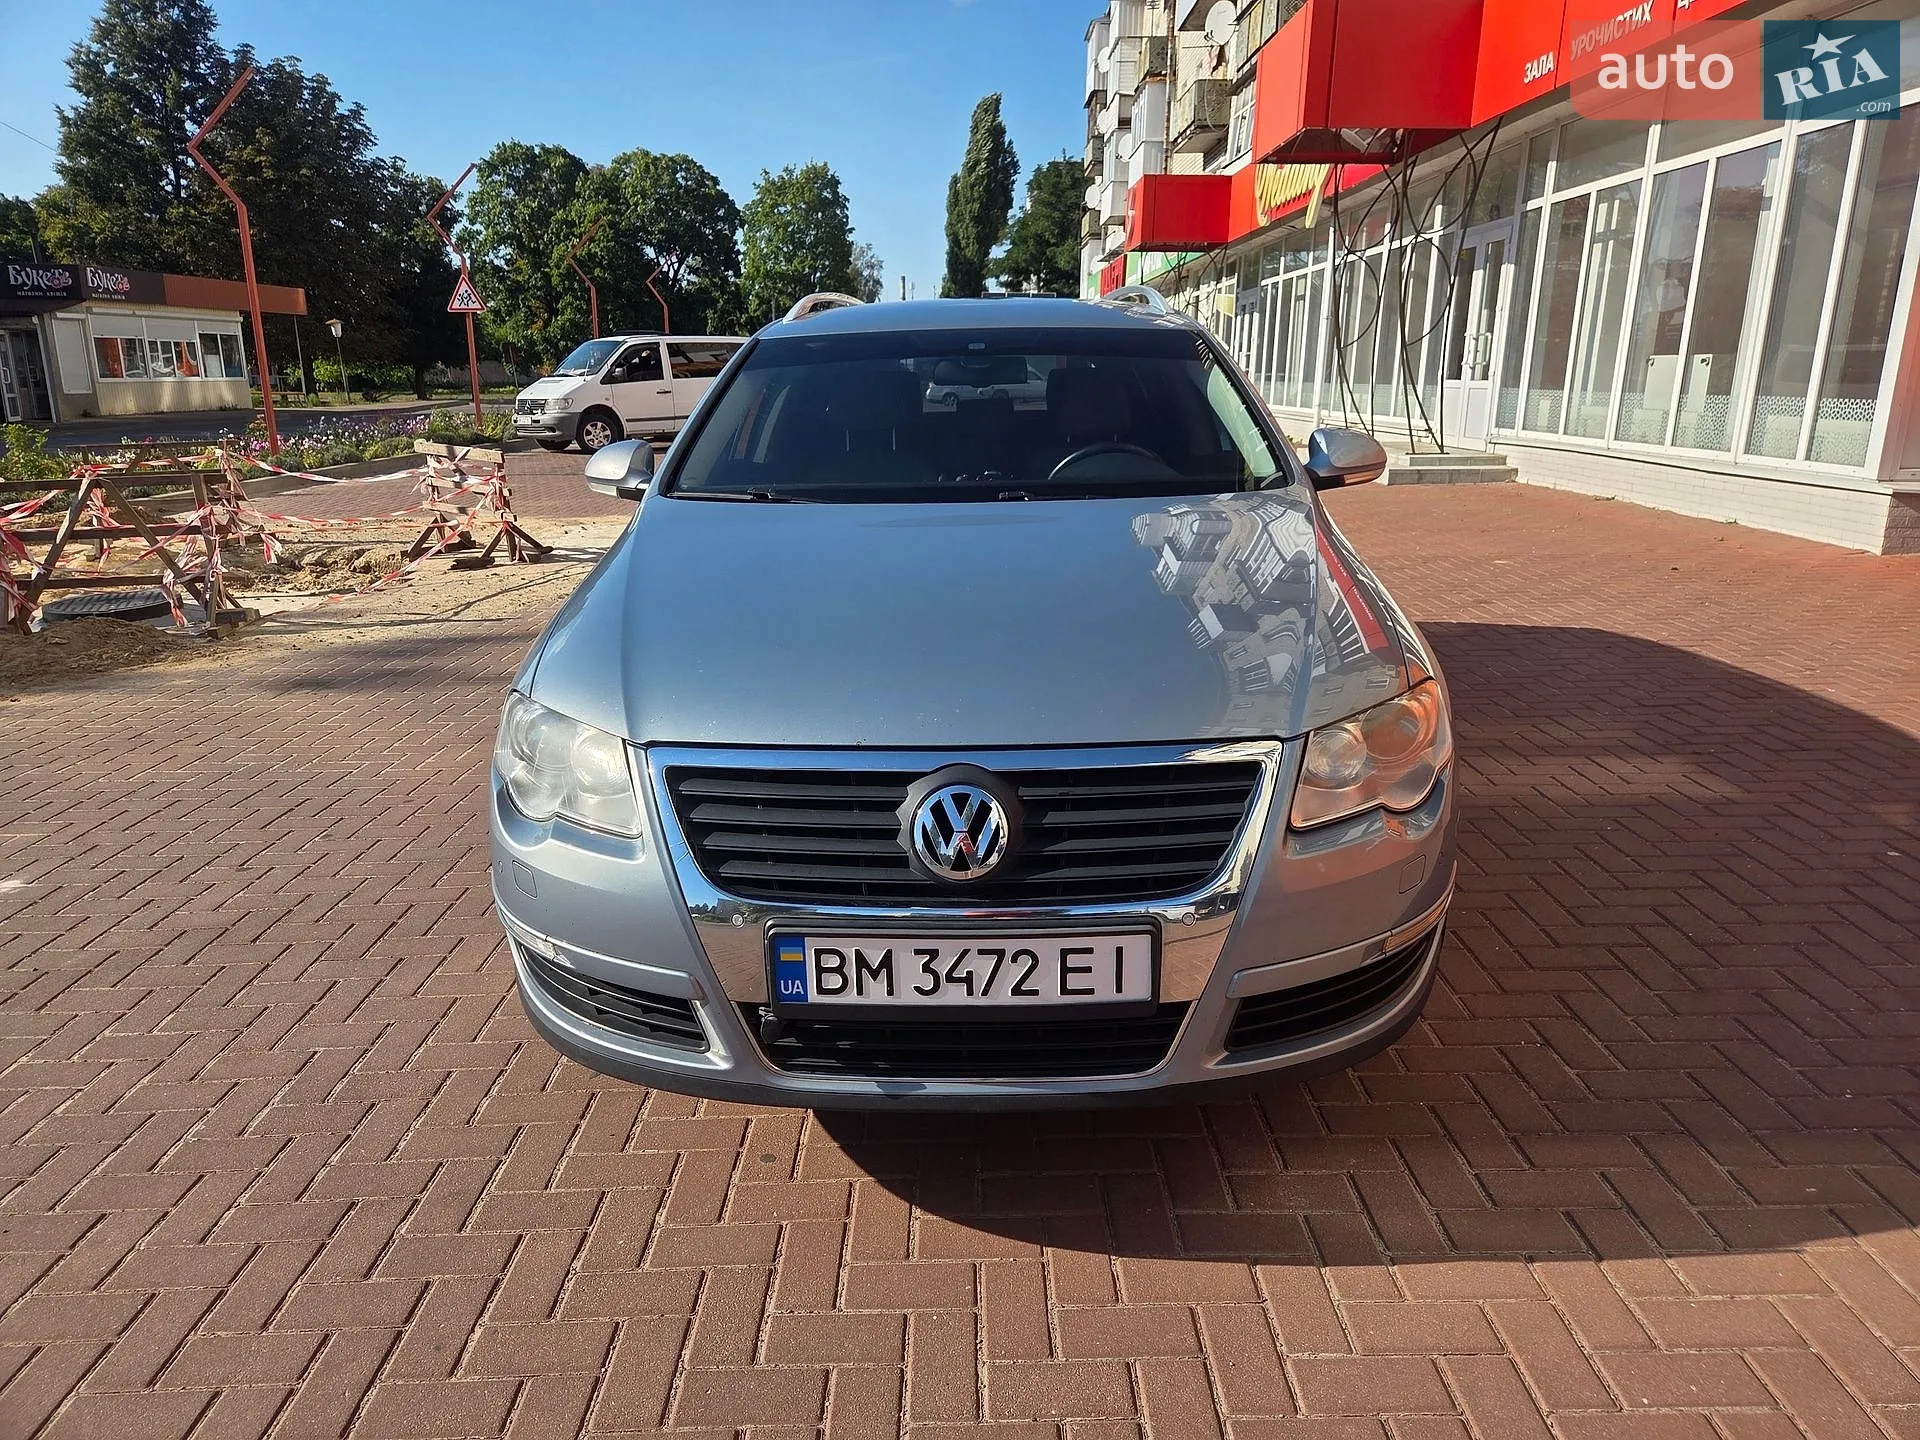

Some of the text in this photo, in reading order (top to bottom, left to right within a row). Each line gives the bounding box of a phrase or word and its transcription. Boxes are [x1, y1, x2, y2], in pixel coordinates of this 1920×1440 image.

[1523, 0, 1654, 84] ЗАЛА УРОЧИСТИХ
[780, 979, 804, 995] UA
[813, 946, 1124, 997] BM 3472 EI
